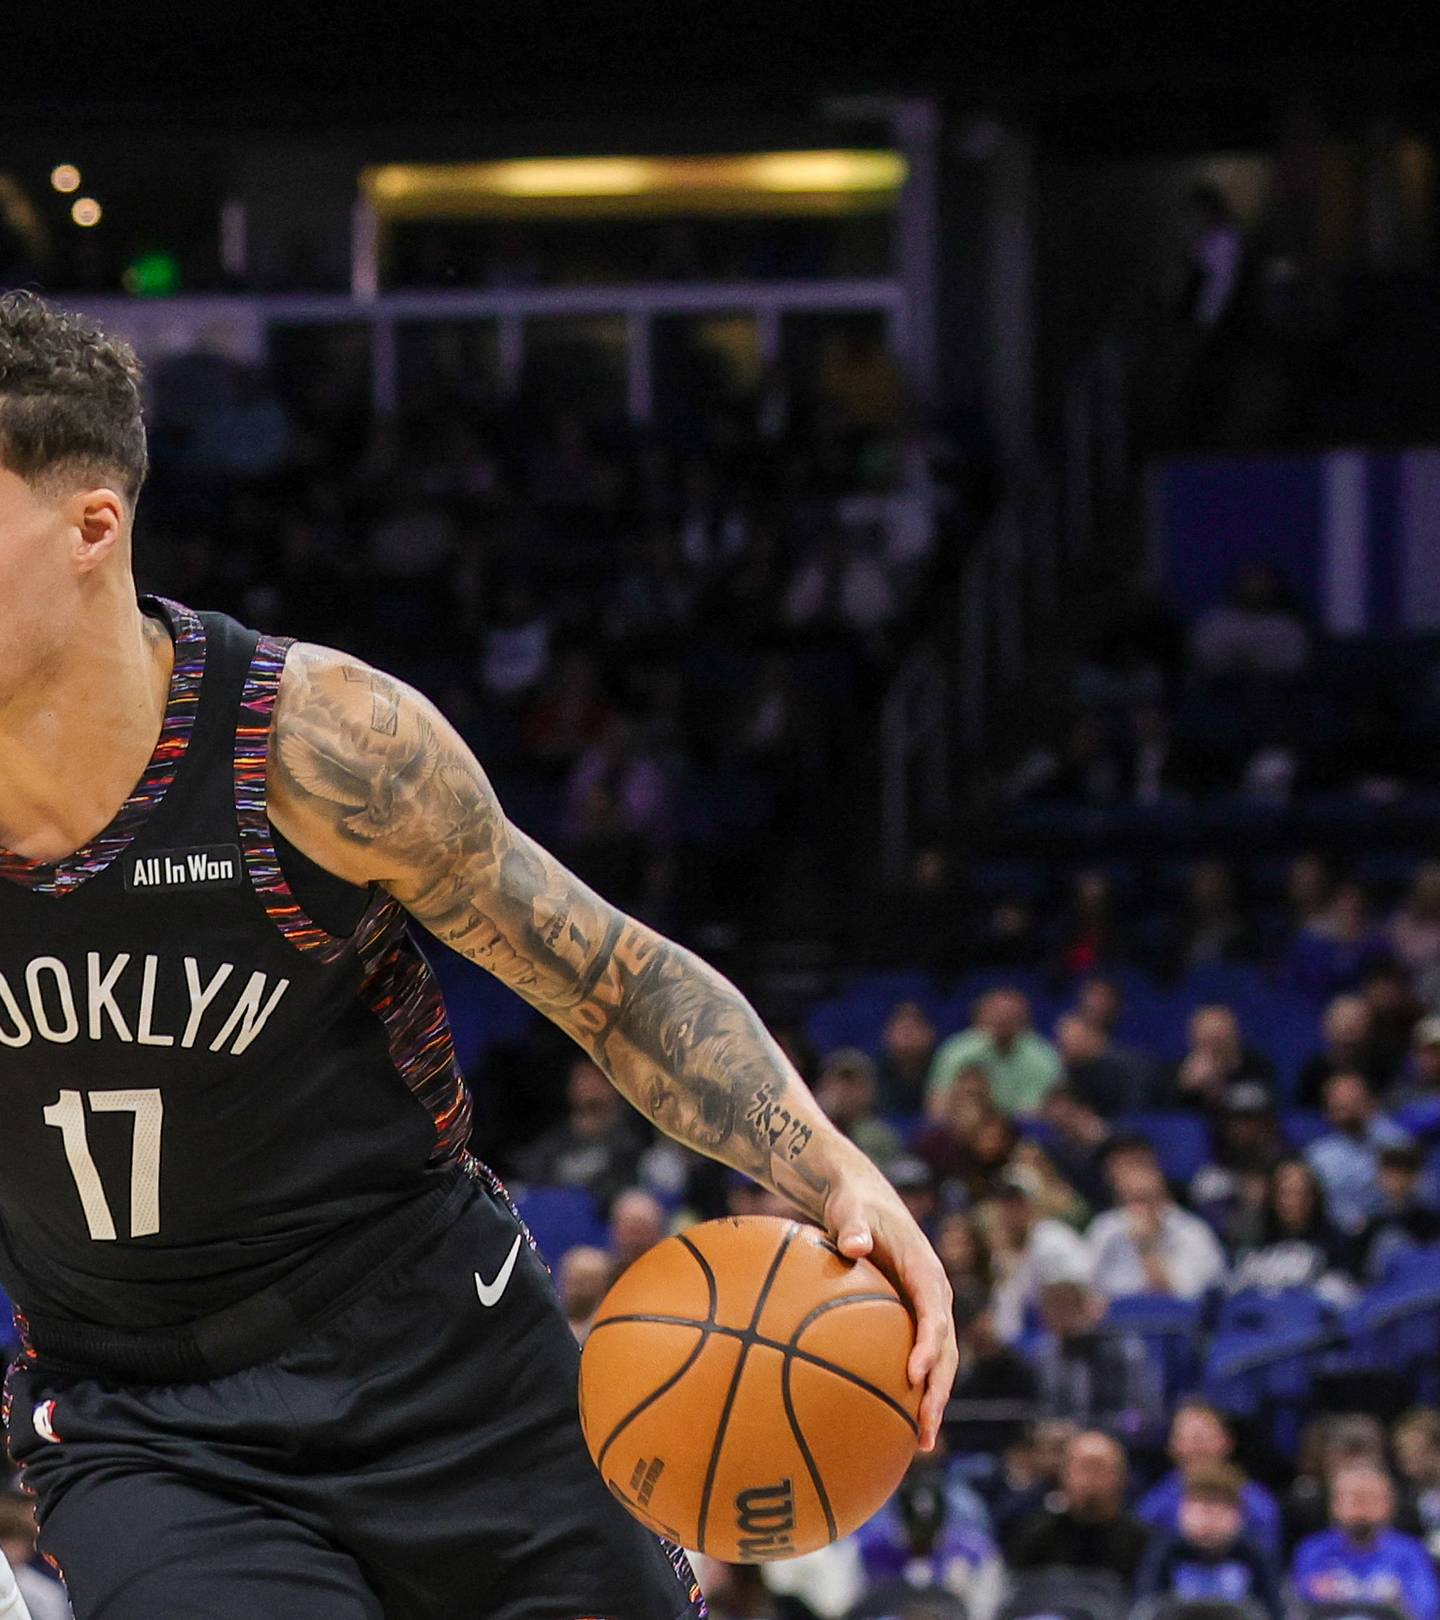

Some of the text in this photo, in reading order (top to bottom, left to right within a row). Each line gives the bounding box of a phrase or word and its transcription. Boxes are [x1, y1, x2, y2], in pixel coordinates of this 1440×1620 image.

[133, 853, 233, 886] All In Won
[43, 1088, 163, 1240] 17
